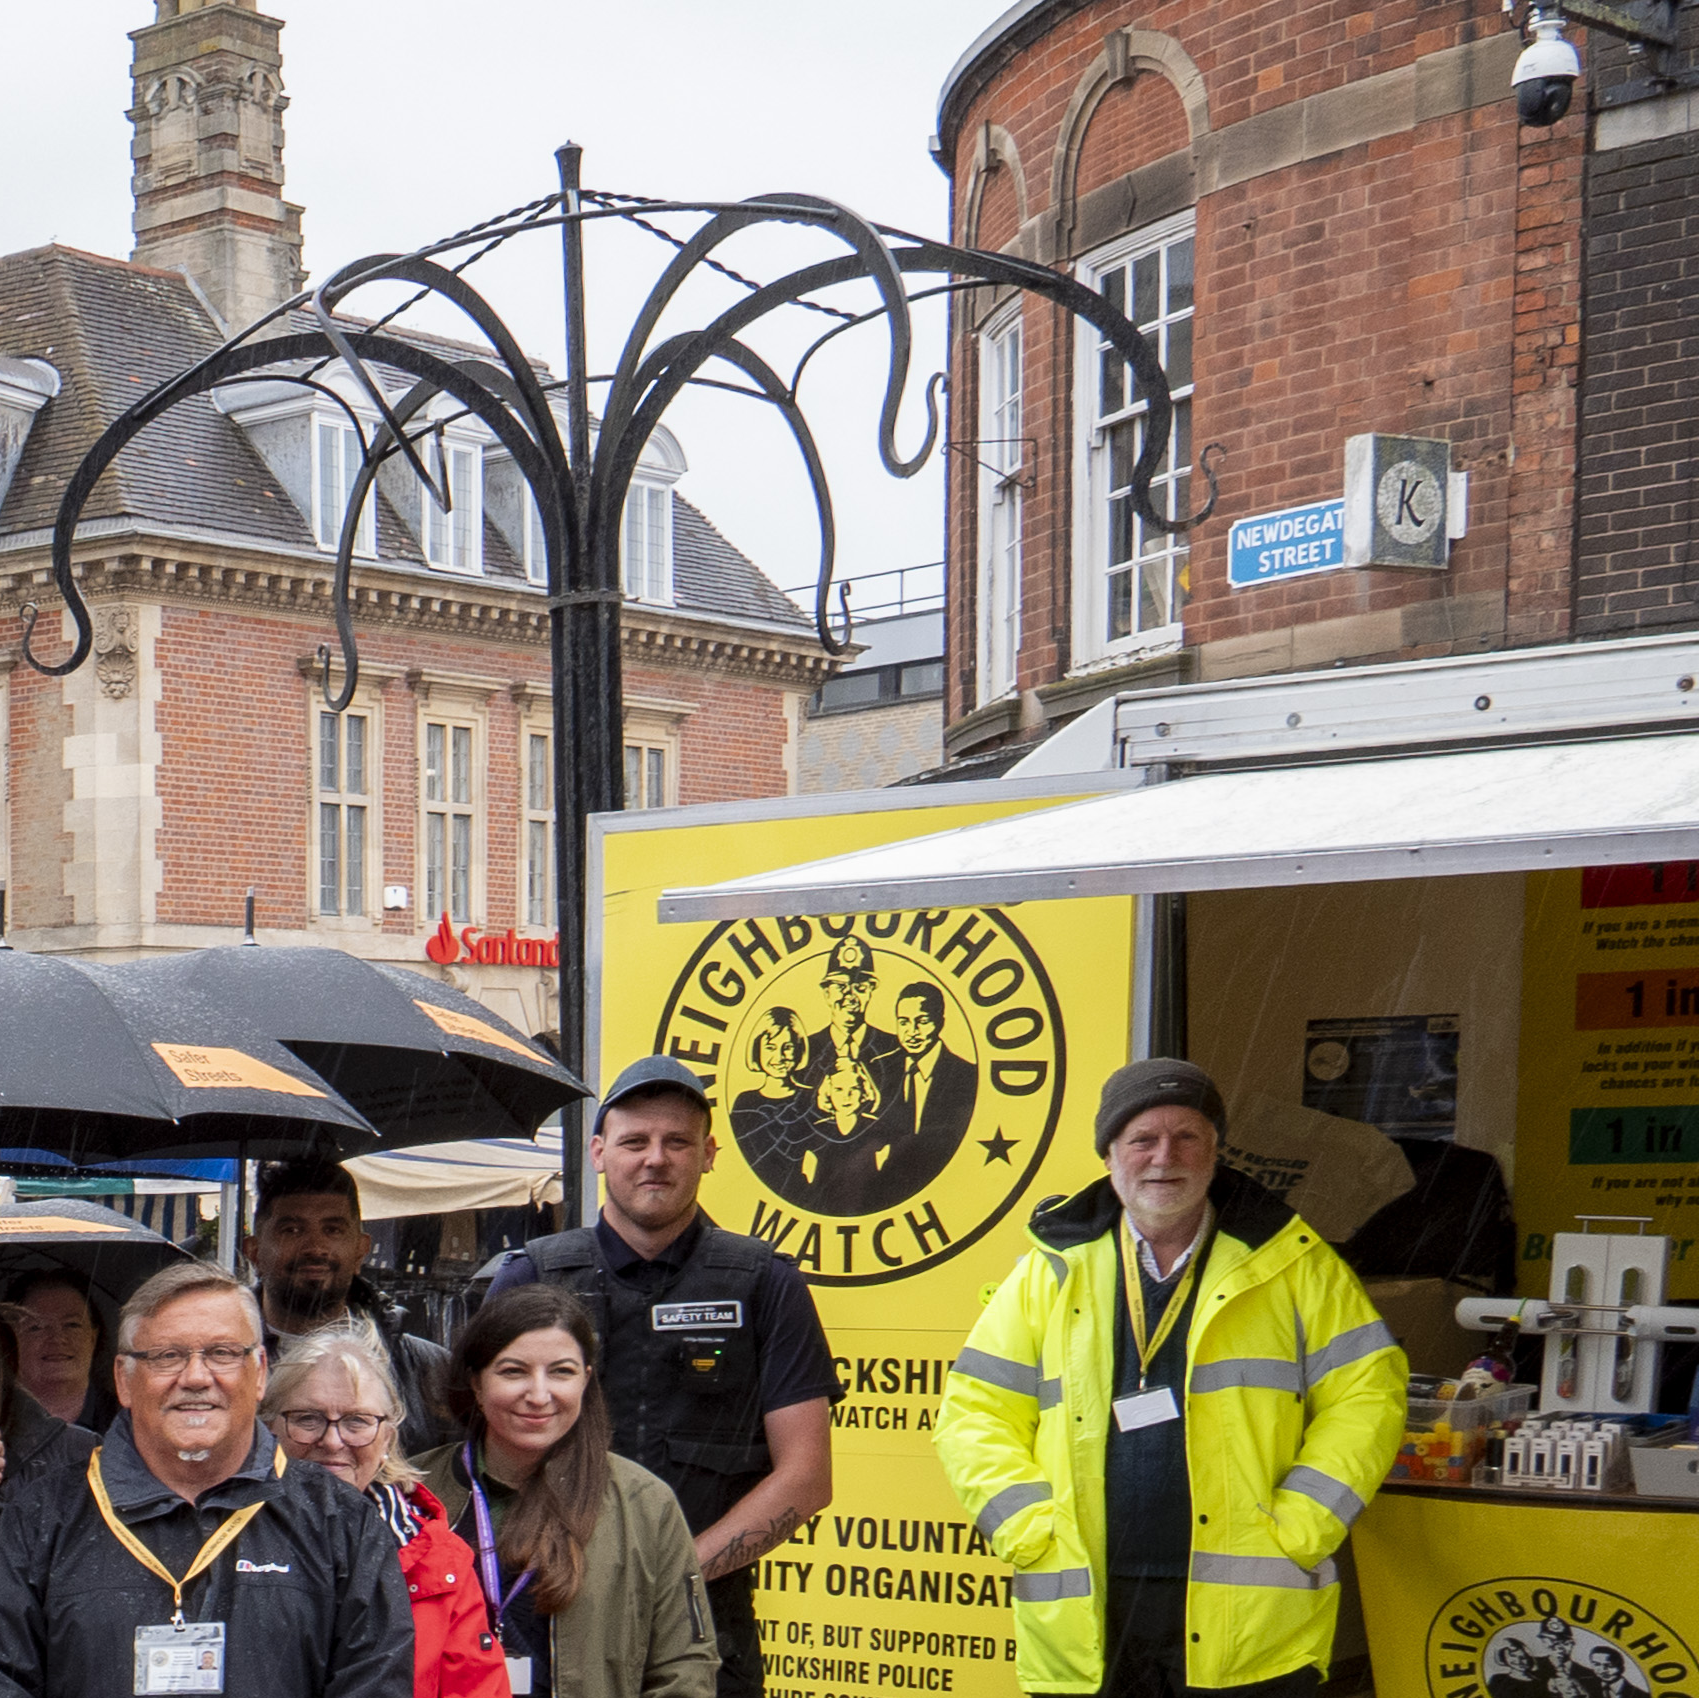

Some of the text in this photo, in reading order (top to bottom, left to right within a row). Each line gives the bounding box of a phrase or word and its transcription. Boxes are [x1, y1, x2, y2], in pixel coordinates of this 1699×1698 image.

[1395, 478, 1427, 528] K
[1236, 507, 1344, 551] NEWDEGAT
[1258, 537, 1337, 573] STREET
[1665, 918, 1699, 929] mem
[460, 926, 560, 967] Santand
[1626, 980, 1644, 1018] 1
[168, 1049, 211, 1065] Safer
[184, 1068, 243, 1083] Streets
[1606, 1116, 1683, 1153] 1 in
[749, 1199, 952, 1273] WATCH
[661, 1311, 734, 1324] SAFETY TEAM
[832, 1356, 956, 1395] CKSHI
[834, 1516, 998, 1557] VOLUNTA
[825, 1564, 1014, 1609] ORGANISAT
[756, 1618, 1017, 1662] NT OF, BUT SUPPORTED B
[762, 1653, 954, 1692] WICKSHIRE POLICE
